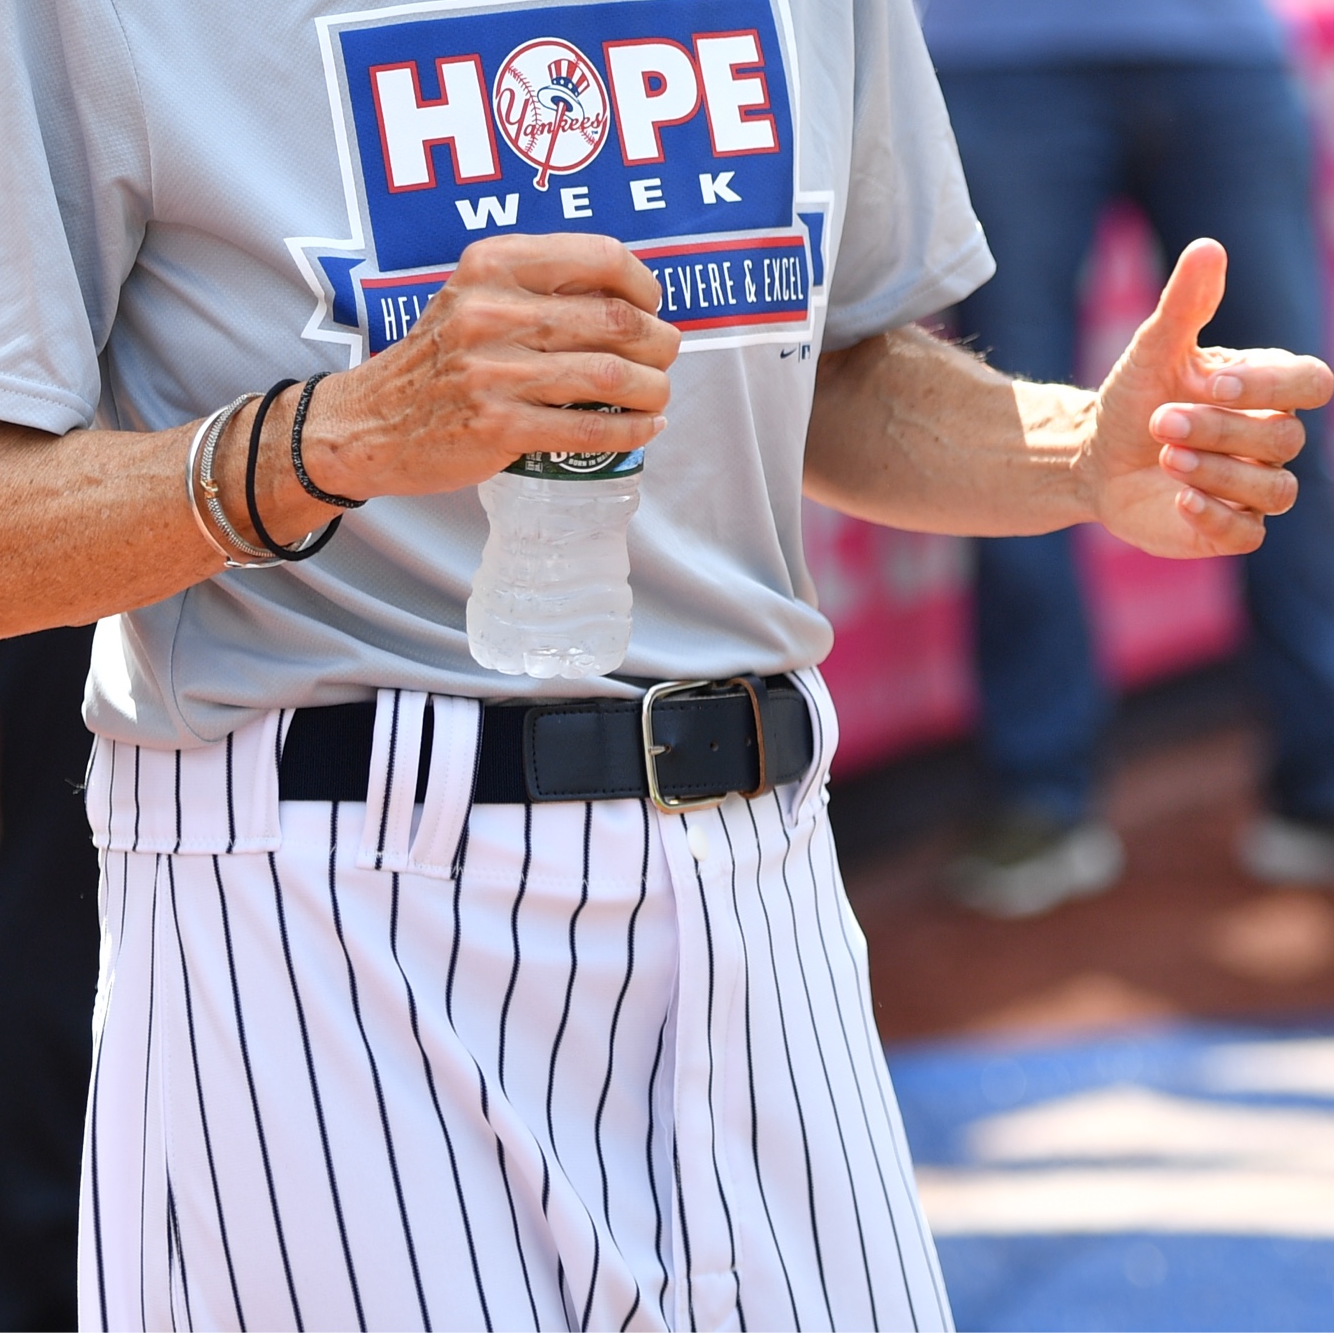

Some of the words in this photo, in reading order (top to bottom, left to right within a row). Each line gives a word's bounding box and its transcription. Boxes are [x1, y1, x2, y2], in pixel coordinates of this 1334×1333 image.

[369, 29, 780, 194] HOPE
[496, 87, 609, 144] Yankees
[455, 170, 743, 231] WEEK
[743, 259, 757, 304] &
[763, 256, 804, 303] EXCEL
